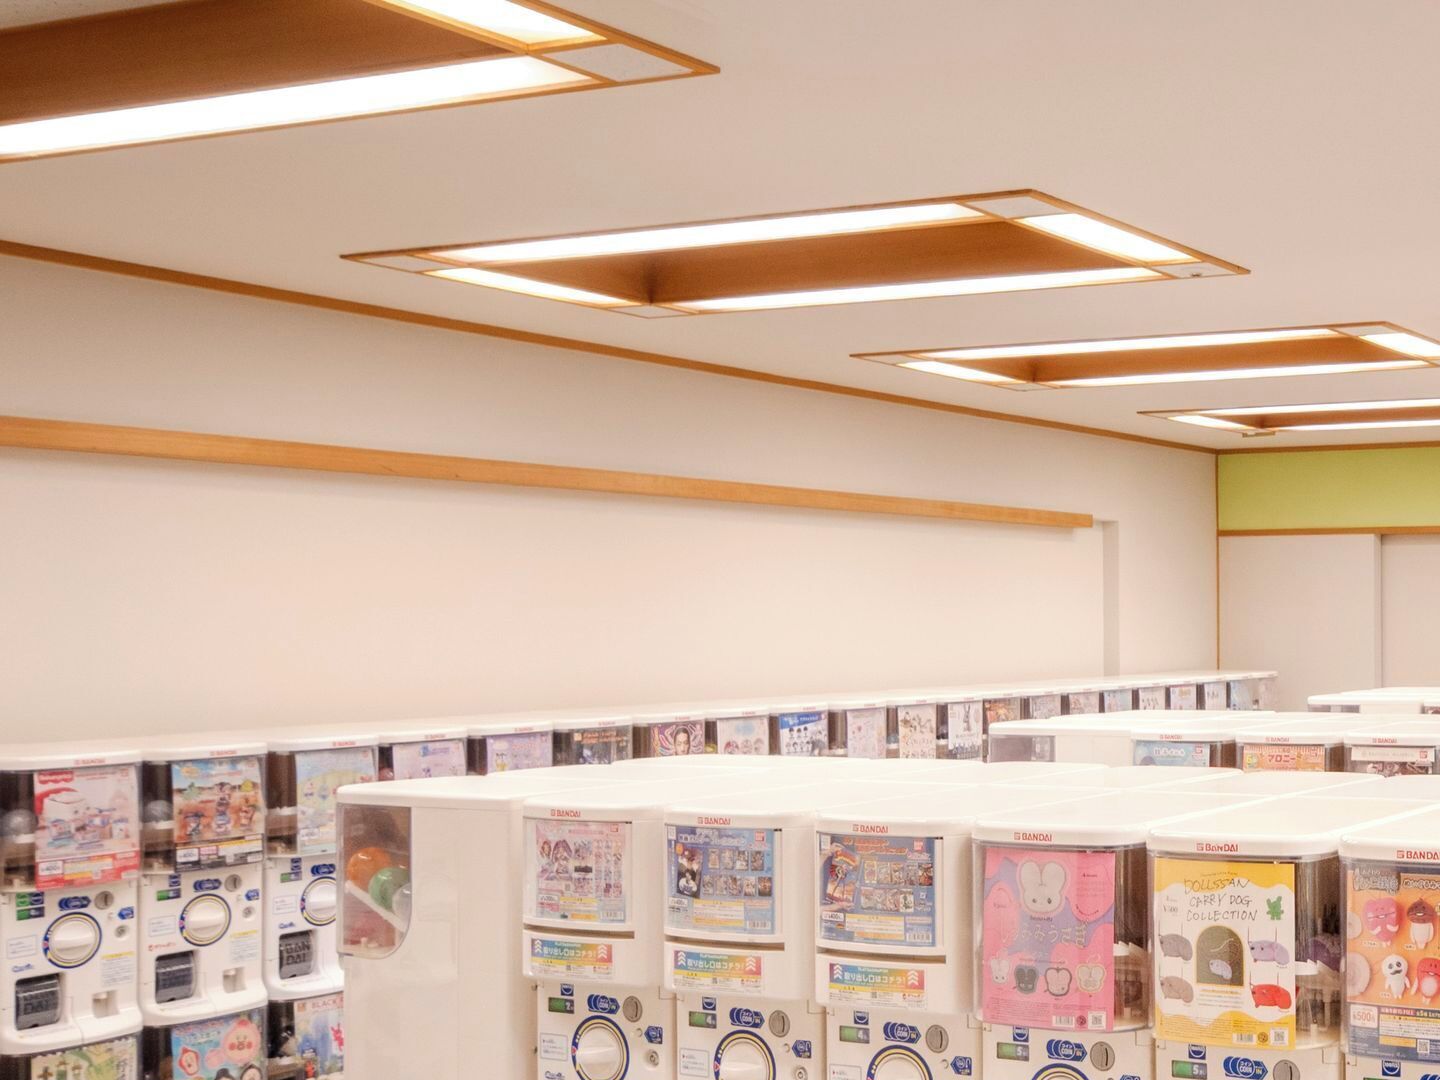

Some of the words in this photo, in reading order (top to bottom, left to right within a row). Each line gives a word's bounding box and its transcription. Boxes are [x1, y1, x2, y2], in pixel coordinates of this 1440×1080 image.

[556, 809, 581, 817] BANDAI
[704, 817, 731, 825] BANDAI
[859, 825, 888, 833] BANDAI
[1021, 833, 1052, 842] BANDAI
[1205, 843, 1239, 852] BANDAI
[1189, 893, 1227, 907] CARRY
[1230, 895, 1253, 906] DOG
[1186, 910, 1257, 922] COLLECTION
